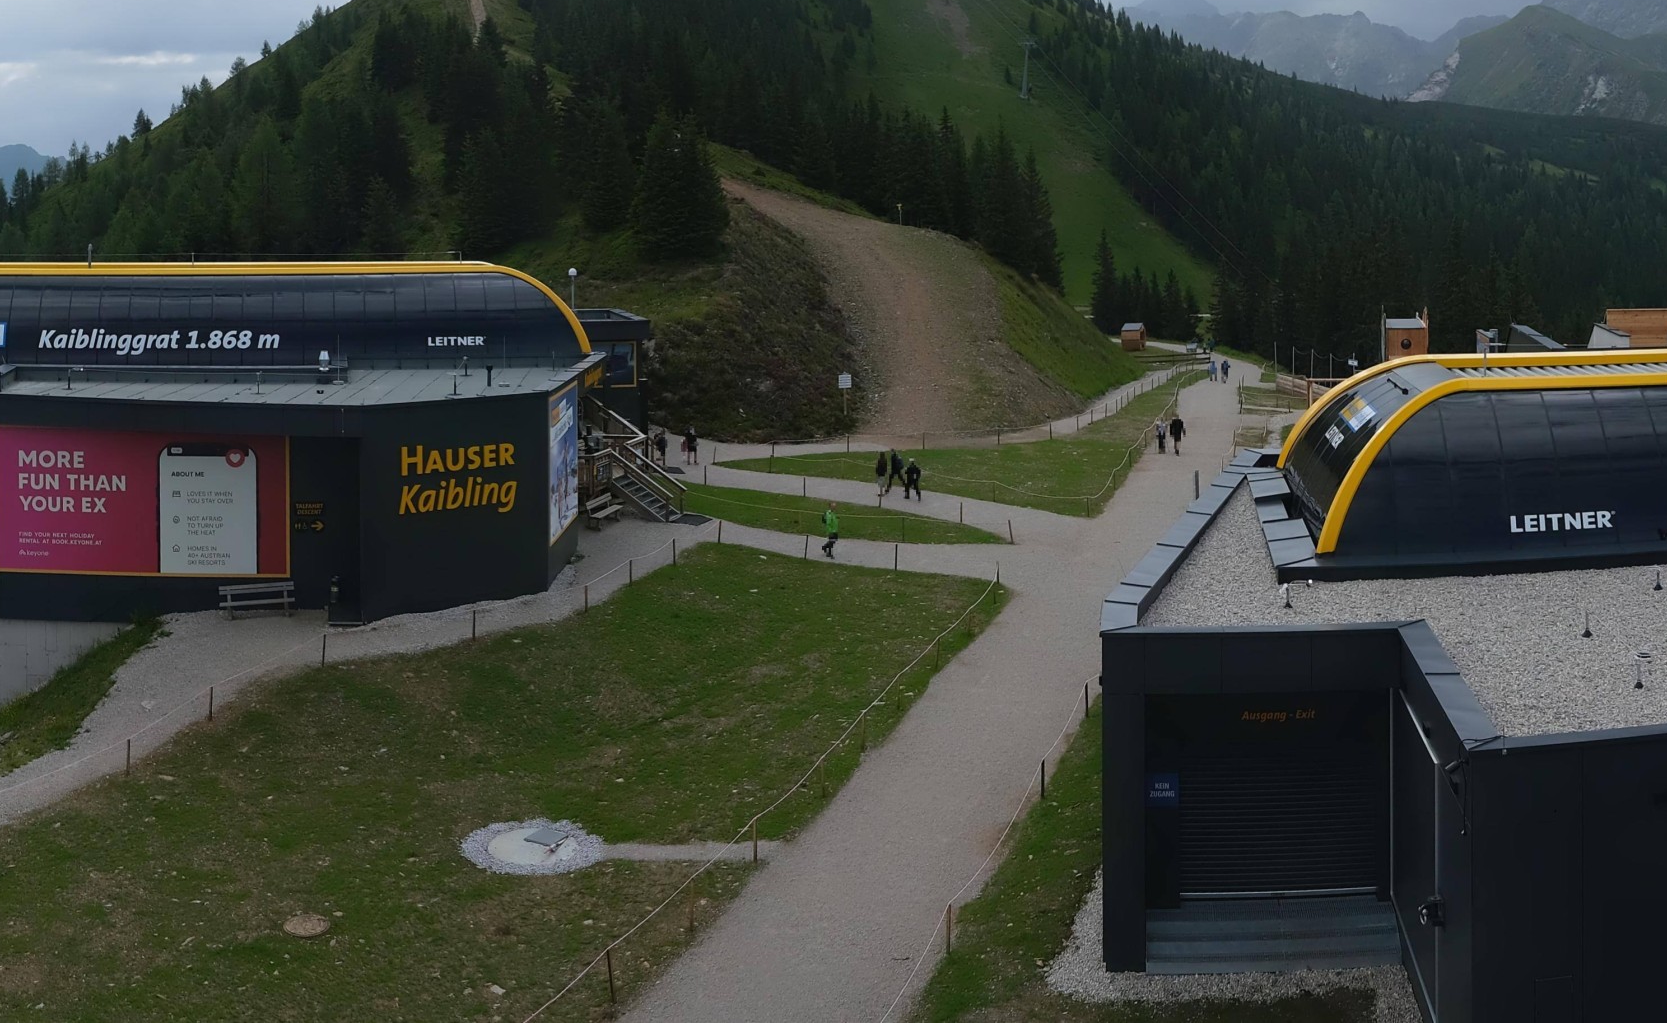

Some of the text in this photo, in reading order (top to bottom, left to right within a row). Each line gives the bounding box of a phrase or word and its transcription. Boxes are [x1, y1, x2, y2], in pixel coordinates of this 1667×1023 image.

[38, 329, 280, 356] Kaiblinggrat 1.868 m
[427, 336, 485, 347] LEITNER
[18, 450, 85, 468] MORE
[401, 442, 516, 476] HAUSER
[18, 473, 127, 491] FUN THAN
[19, 496, 107, 513] YOUR EX
[398, 476, 518, 515] Kaibling
[1510, 510, 1613, 533] LEITNER
[1241, 711, 1287, 722] Ausgang
[1295, 709, 1316, 719] Exit
